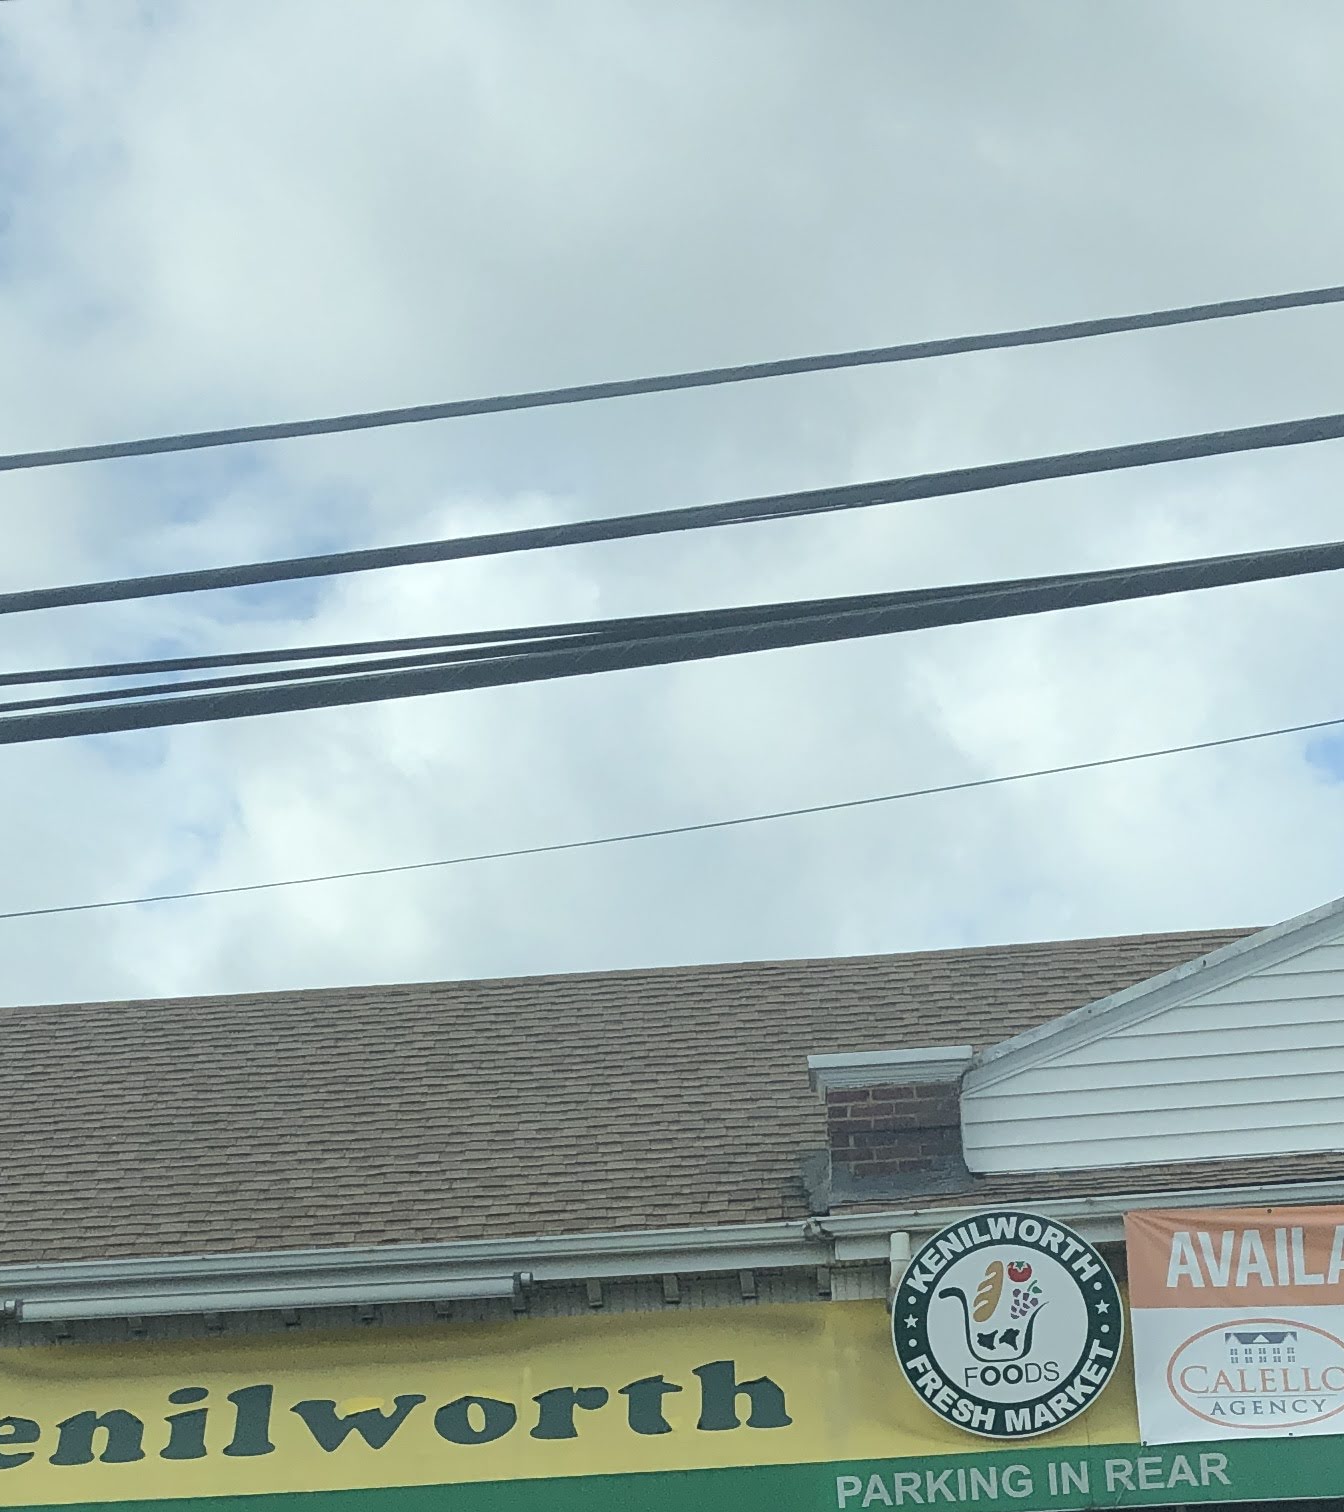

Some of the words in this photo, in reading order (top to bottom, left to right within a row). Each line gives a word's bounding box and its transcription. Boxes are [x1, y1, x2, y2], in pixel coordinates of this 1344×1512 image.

[906, 1216, 1102, 1295] KENILWORTH
[906, 1353, 996, 1432] FRESH
[1004, 1338, 1114, 1433] MARKET
[964, 1361, 1060, 1388] FOODS
[1211, 1398, 1328, 1418] AGENCY
[836, 1463, 1032, 1510] PARKING
[1047, 1460, 1092, 1497] IN
[1105, 1452, 1231, 1495] REAR
